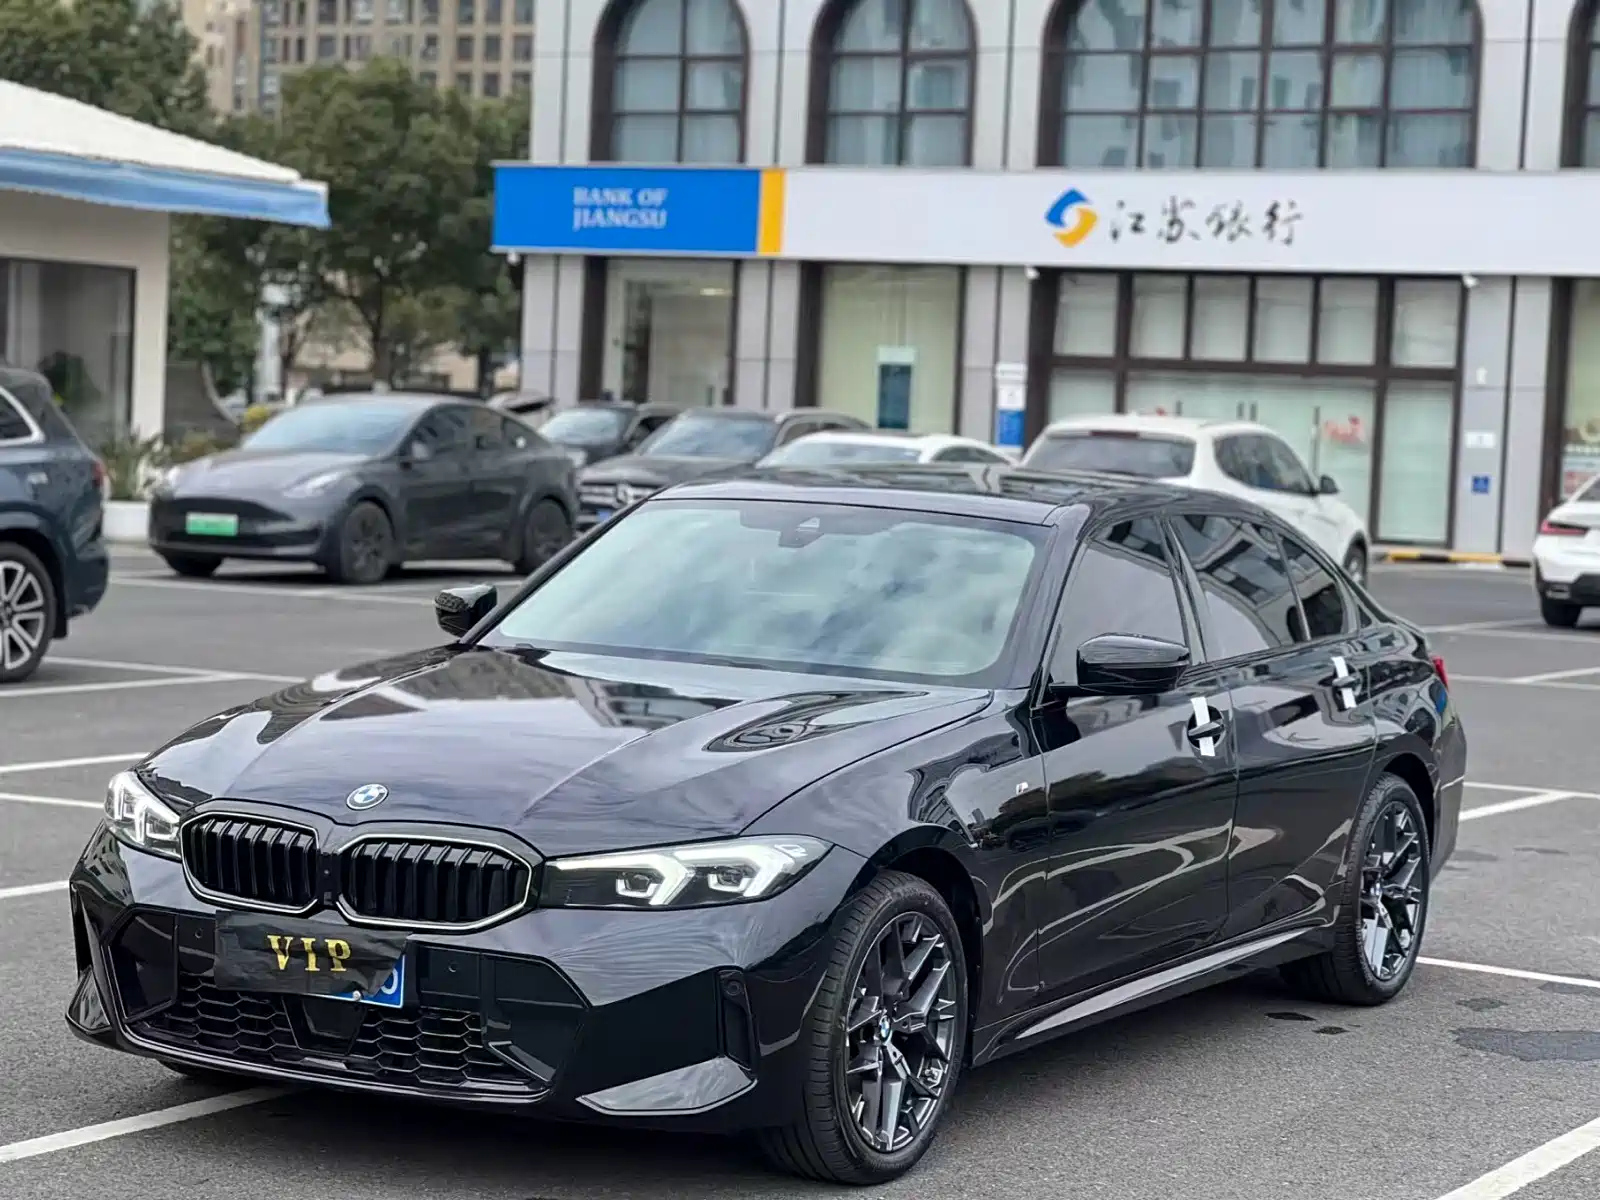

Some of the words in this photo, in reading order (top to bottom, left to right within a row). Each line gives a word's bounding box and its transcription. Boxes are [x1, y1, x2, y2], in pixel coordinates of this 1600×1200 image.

[573, 187, 632, 206] BANK
[637, 187, 668, 206] OF
[572, 208, 667, 231] JIANGSU
[1109, 196, 1303, 246] 江苏银行
[266, 935, 351, 971] VIP
